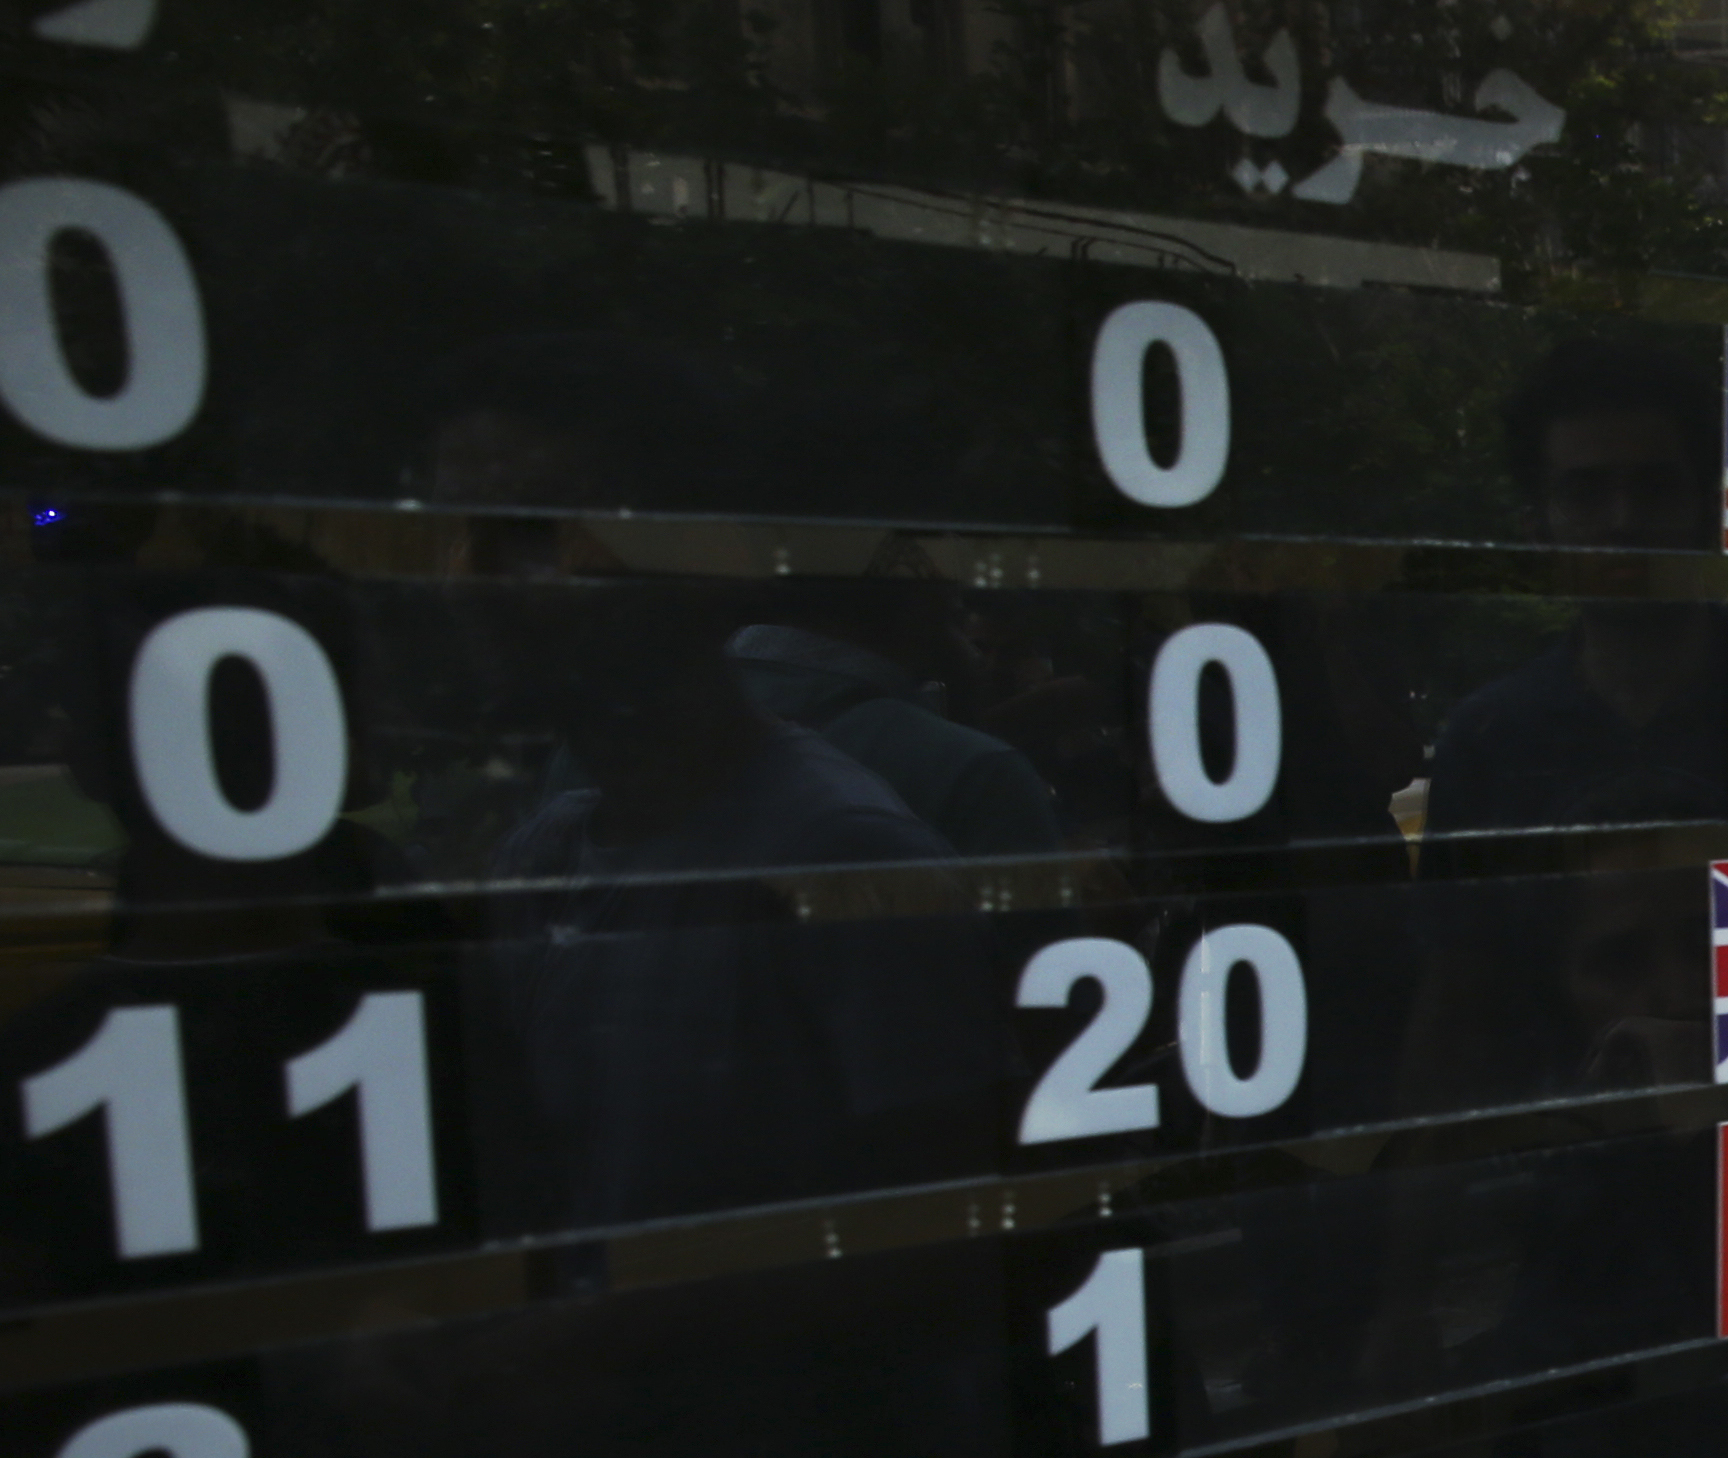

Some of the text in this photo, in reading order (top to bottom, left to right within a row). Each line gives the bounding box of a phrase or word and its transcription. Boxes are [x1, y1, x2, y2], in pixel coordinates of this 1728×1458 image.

[1156, 3, 1567, 205] خرید
[0, 178, 207, 452] 0
[1091, 300, 1231, 508] 0
[130, 607, 348, 861] 0
[1148, 622, 1282, 823] 0
[1016, 922, 1308, 1145] 20
[1047, 1247, 1149, 1446] 1
